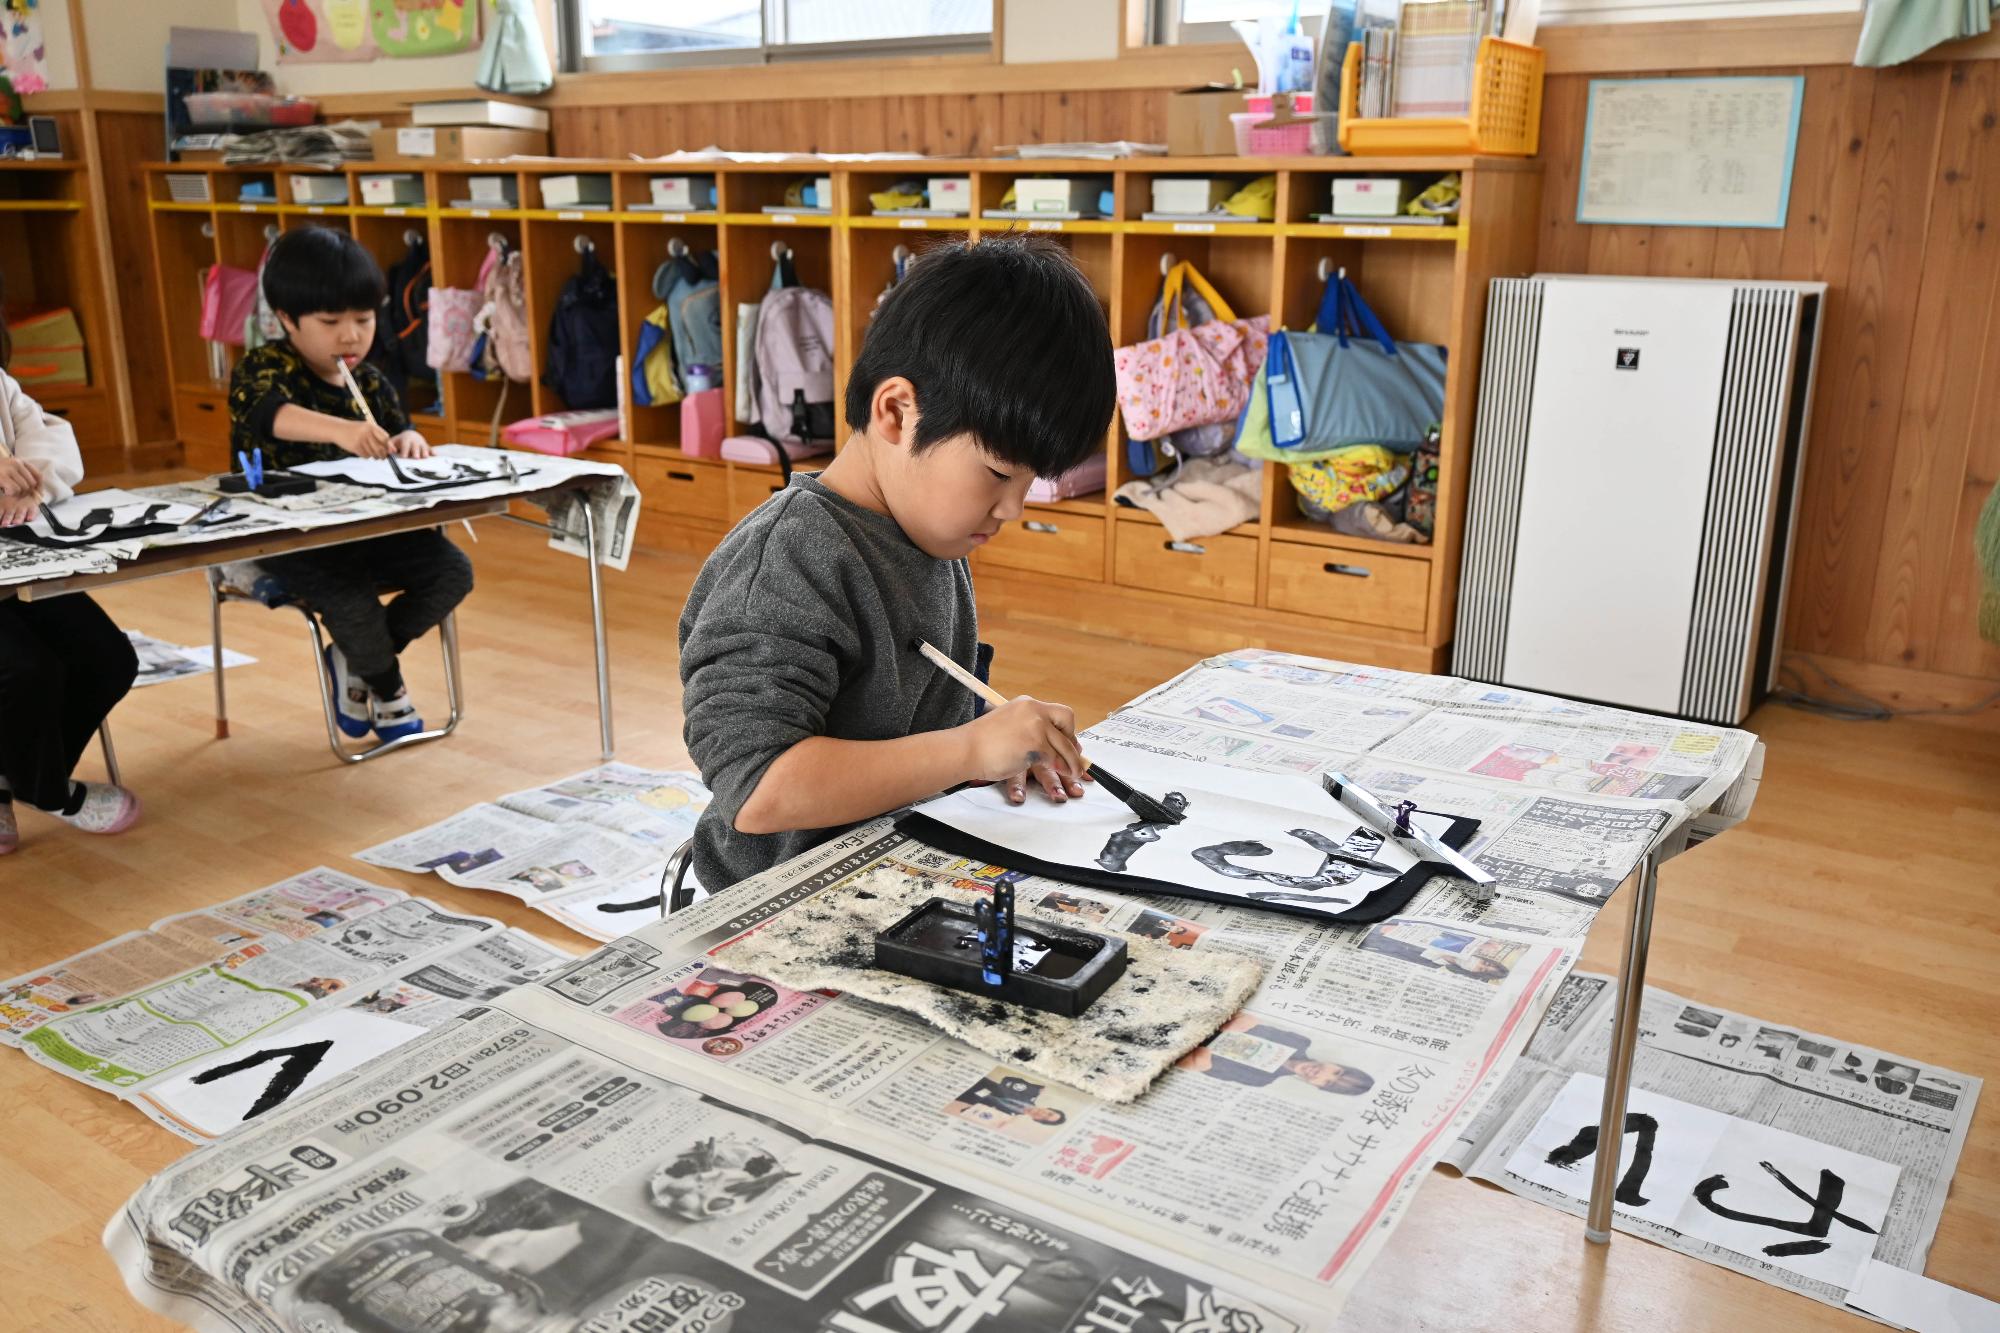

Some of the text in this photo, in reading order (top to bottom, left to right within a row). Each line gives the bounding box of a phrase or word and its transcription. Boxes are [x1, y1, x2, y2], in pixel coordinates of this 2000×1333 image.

[333, 1071, 448, 1139] 2,090円
[1362, 1061, 1441, 1132] 冬の誘客
[1263, 1132, 1382, 1246] サウナと連携
